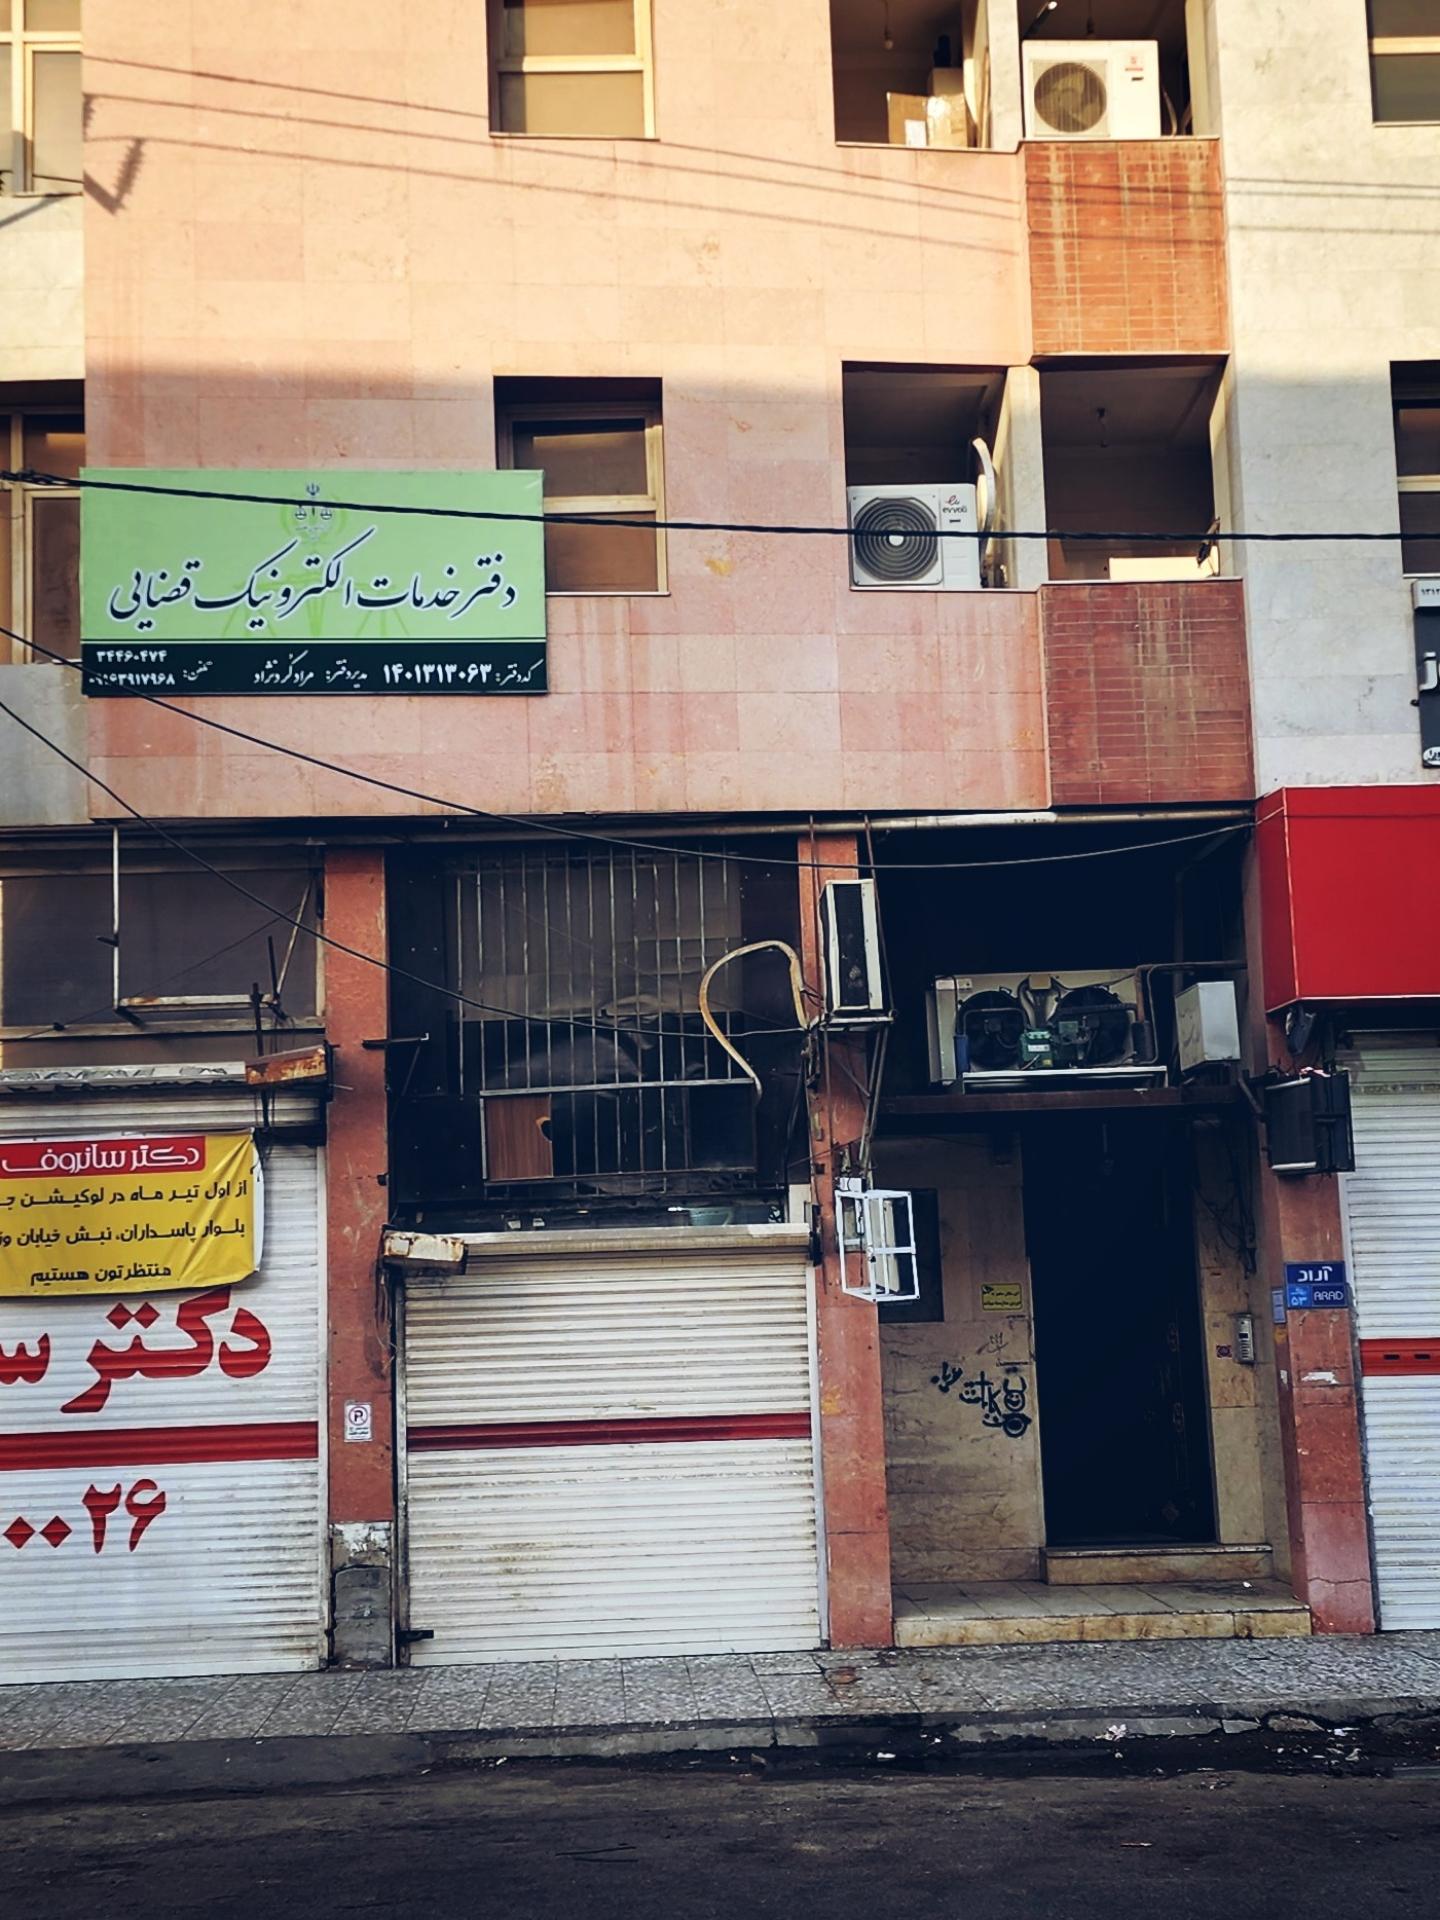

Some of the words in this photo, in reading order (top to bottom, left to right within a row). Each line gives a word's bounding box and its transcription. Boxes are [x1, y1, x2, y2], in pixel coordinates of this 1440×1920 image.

[194, 528, 375, 629] الکترونیک
[357, 566, 460, 609] خدمات
[451, 553, 516, 618] دفتر
[383, 663, 492, 684] ۱۴۰۱۳۱۳۰۶۳
[2, 1143, 127, 1174] سانروف
[130, 1144, 200, 1171] دکتر
[20, 1187, 104, 1208] لوکیشن
[109, 1191, 125, 1205] در
[129, 1186, 163, 1201] ماه
[168, 1184, 199, 1203] تیر
[204, 1181, 231, 1200] اول
[235, 1180, 248, 1197] از
[17, 1228, 61, 1248] خیابان
[66, 1226, 112, 1246] نبش
[201, 1219, 245, 1238] بلوار
[31, 1267, 89, 1286] هستیم
[1297, 1266, 1333, 1282] آراد
[1313, 1290, 1344, 1301] ARAD
[60, 1287, 272, 1413] دکتر
